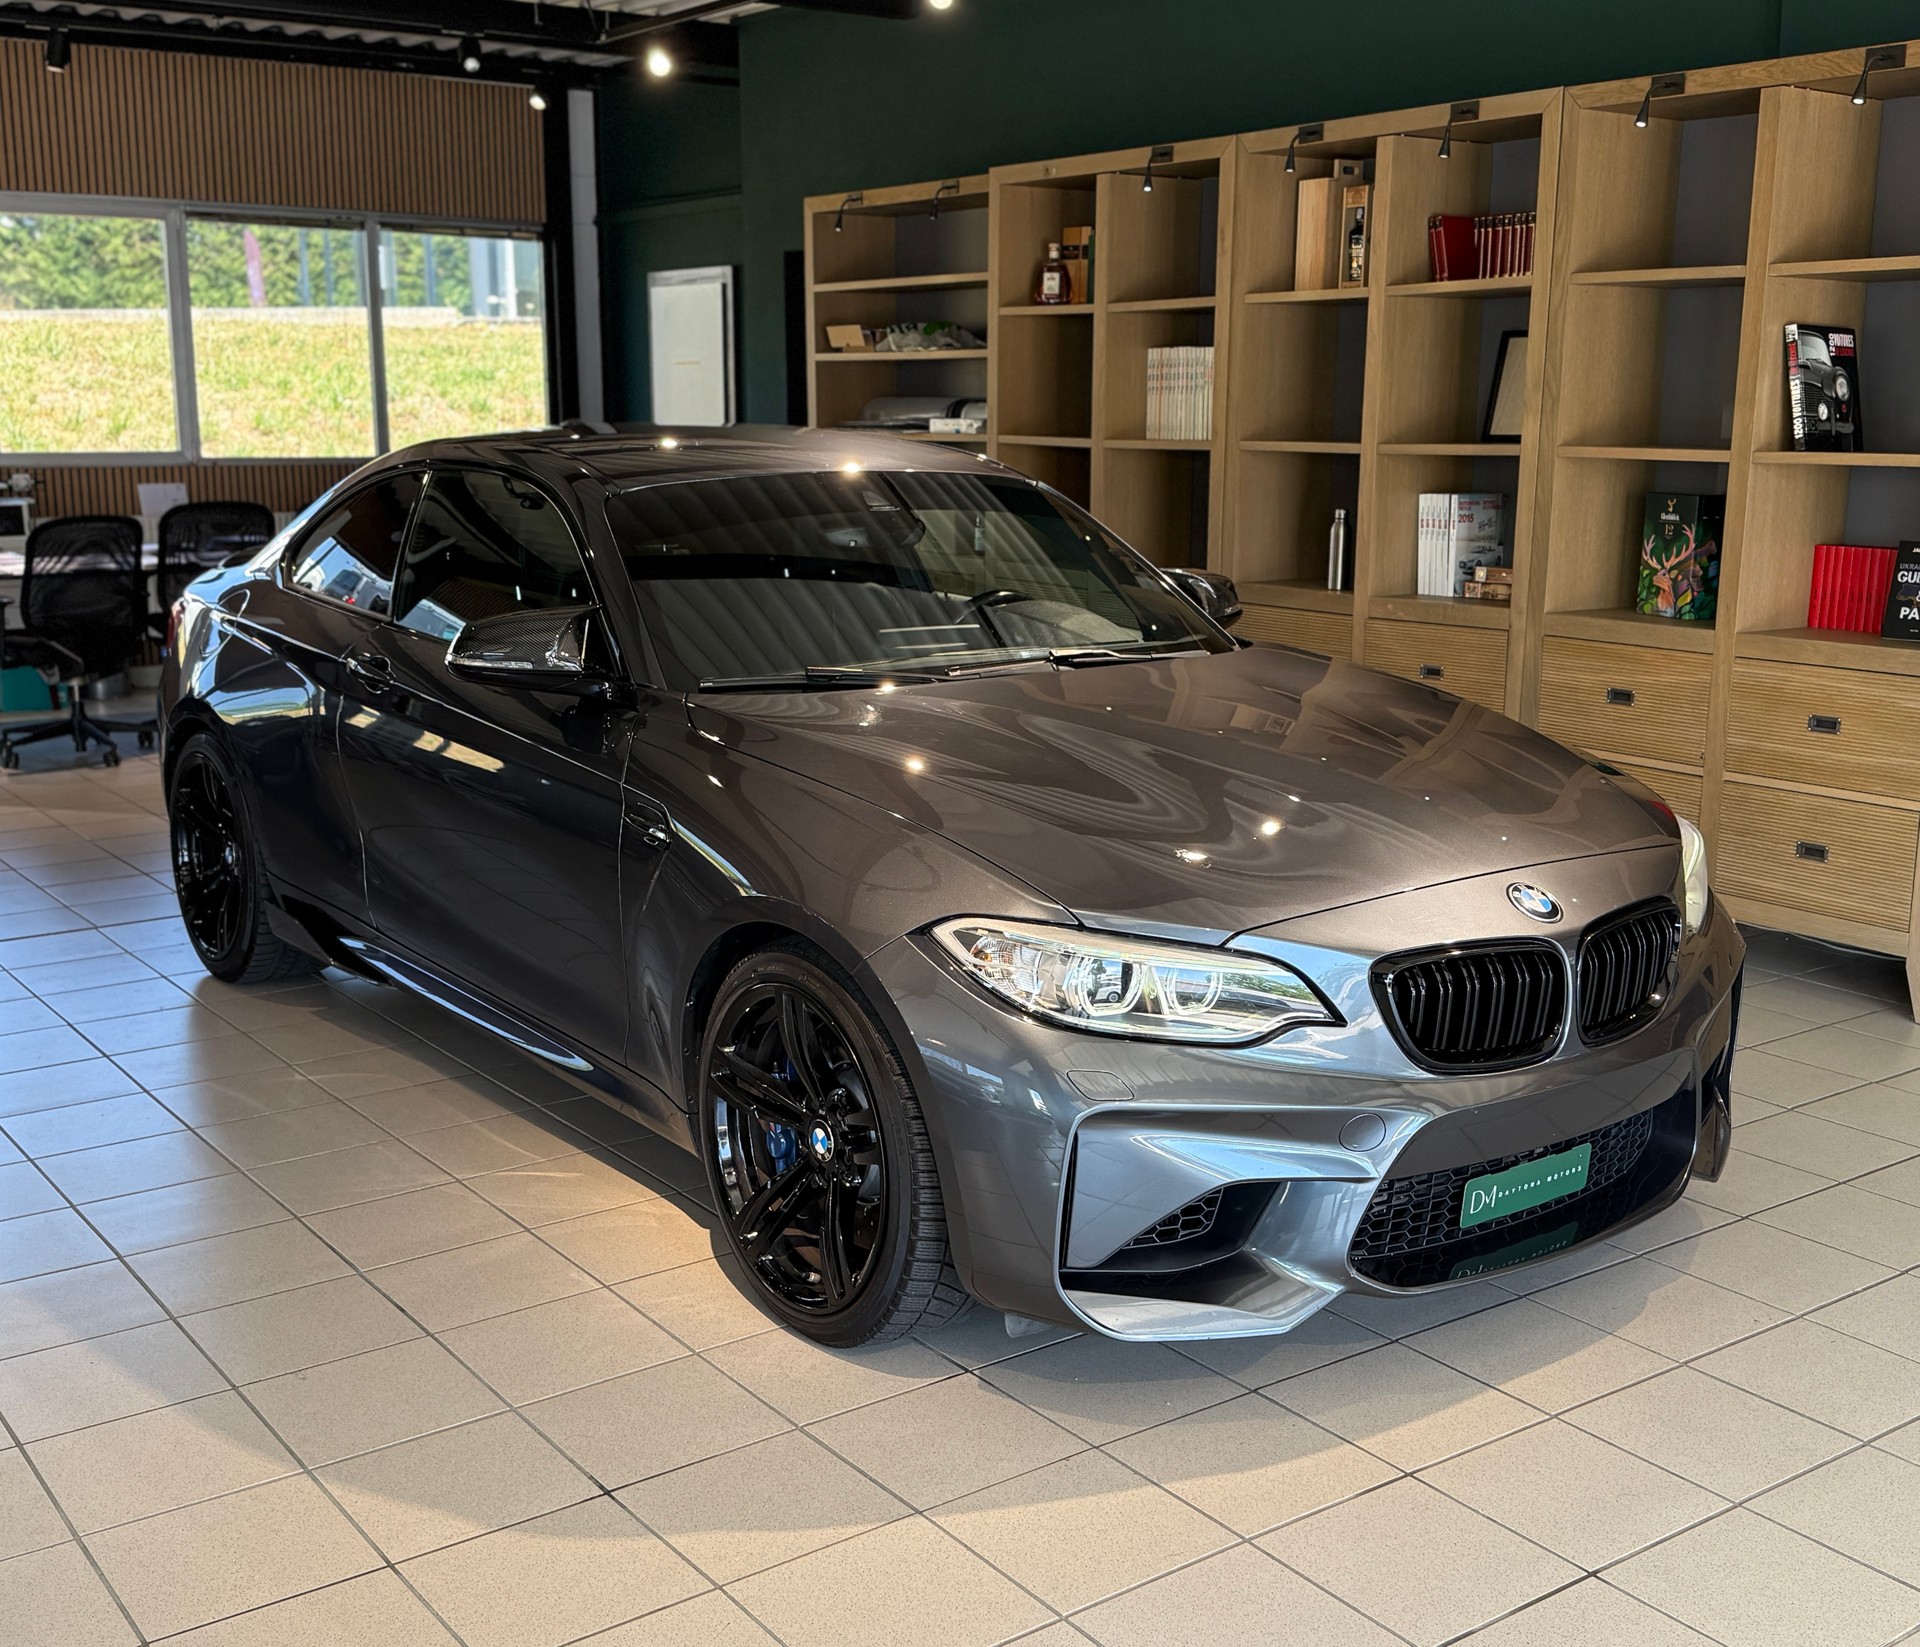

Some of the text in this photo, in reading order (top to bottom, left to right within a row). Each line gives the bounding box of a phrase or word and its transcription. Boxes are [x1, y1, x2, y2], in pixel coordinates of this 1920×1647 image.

[1828, 333, 1836, 357] 1200
[1790, 379, 1802, 418] VOITURES
[1793, 417, 1804, 440] 1200
[1458, 513, 1474, 523] 2015
[1899, 606, 1920, 620] PA
[1498, 1165, 1582, 1199] DAYTONA MOTORS
